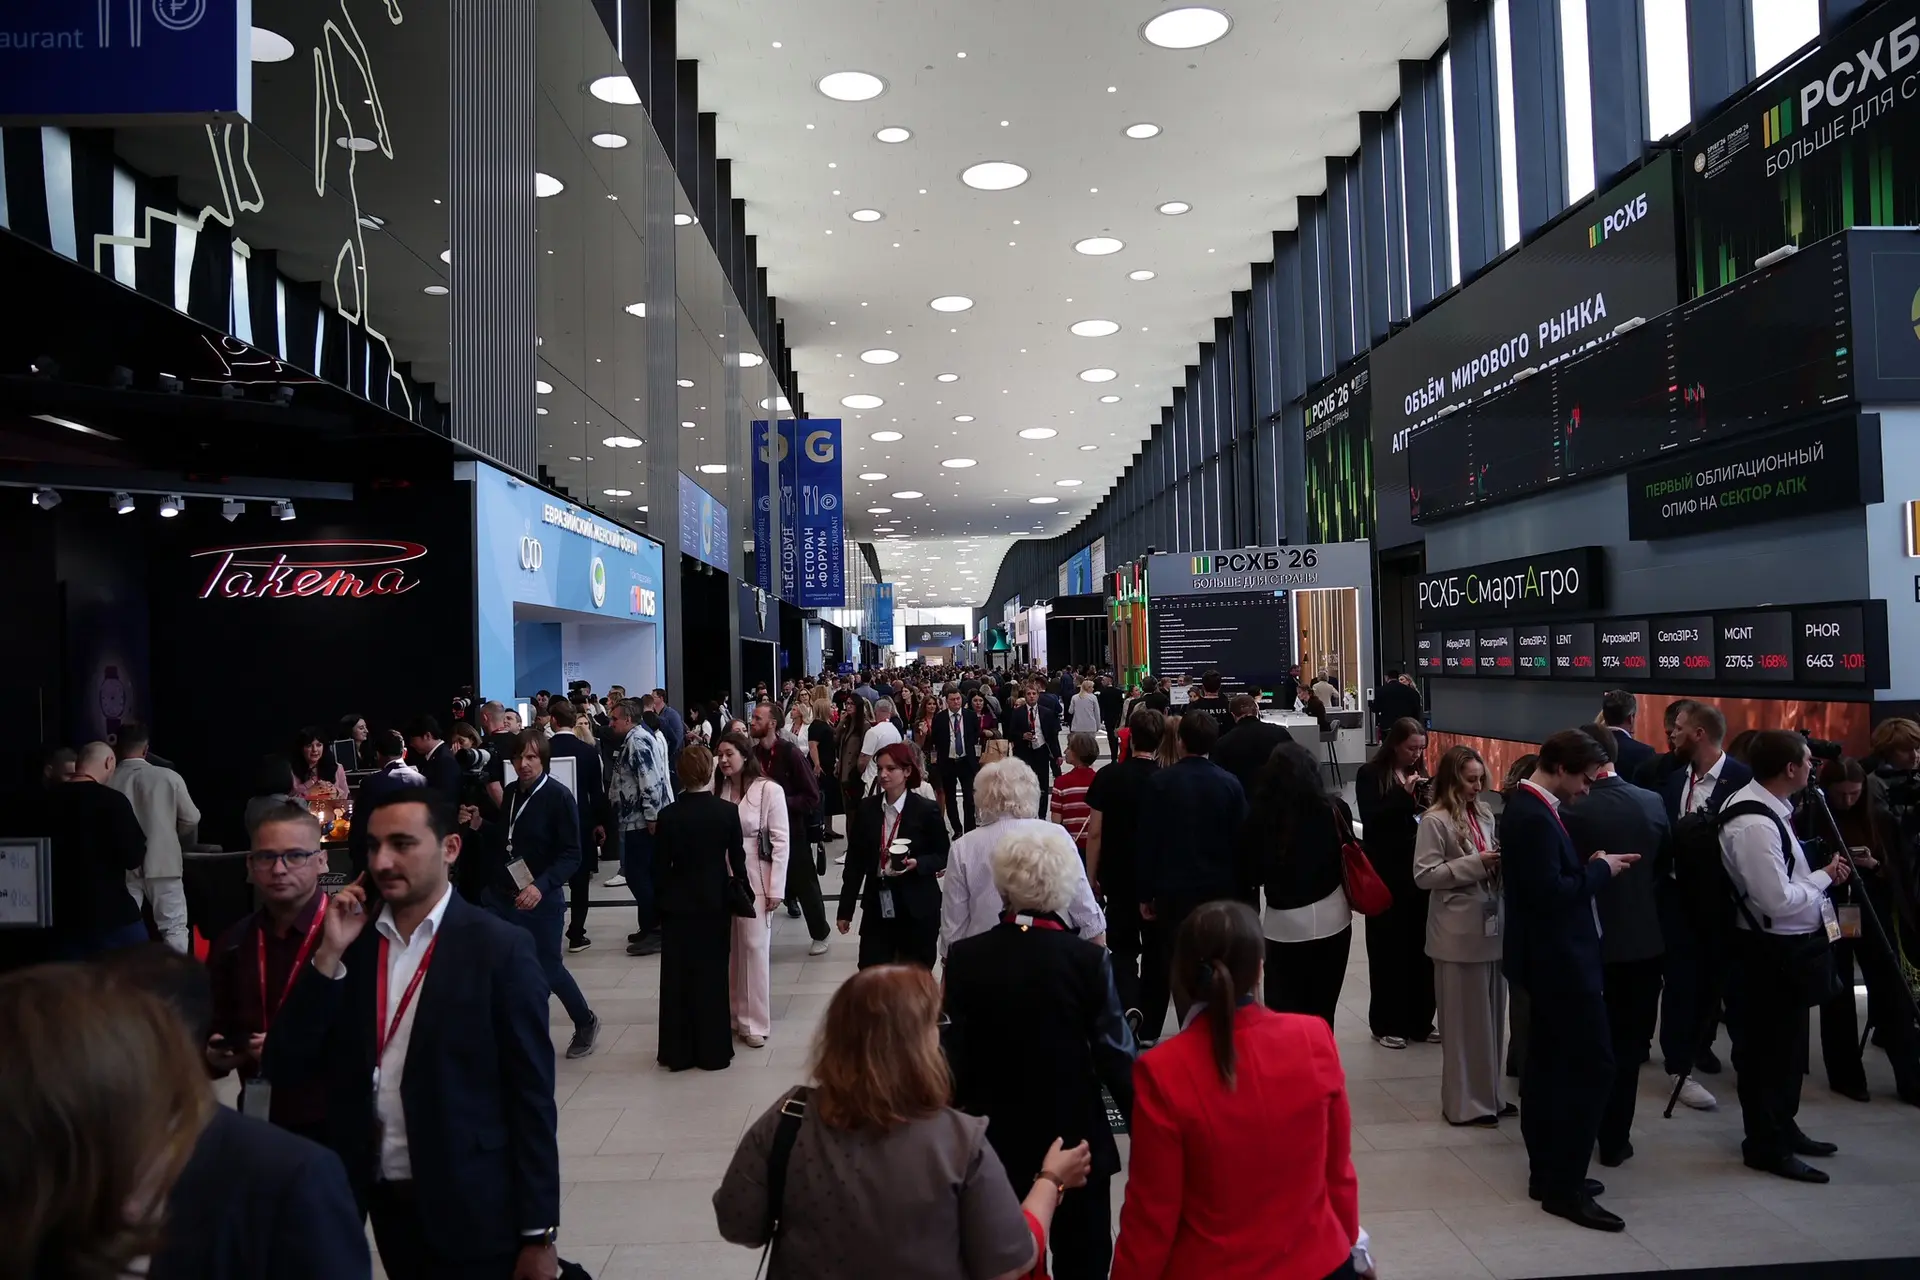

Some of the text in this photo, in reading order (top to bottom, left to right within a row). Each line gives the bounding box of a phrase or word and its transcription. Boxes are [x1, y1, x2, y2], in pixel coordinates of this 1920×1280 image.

[1800, 16, 1920, 126] РСХБ
[1766, 115, 1845, 178] БОЛЬШЕ
[1851, 87, 1894, 135] ДЛЯ
[1901, 71, 1920, 99] С
[1603, 192, 1648, 240] РСХБ
[1404, 375, 1445, 416] ОБЪЁМ
[1451, 332, 1529, 393] МИРОВОГО
[1538, 292, 1607, 350] РЫНКА
[804, 430, 834, 463] G
[1645, 440, 1824, 498] ПЕРВЫЙ ОБЛИГАЦИОННЫЙ
[1661, 476, 1808, 518] ОПИФ НА СЕКТОР АПК
[543, 503, 638, 555] ЕВРАЗИЙСКИЙ ЖЕНСКИЙ ФОРУМ
[805, 527, 815, 588] РЕСТОРАН
[817, 530, 830, 588] «ФОРУМ»
[831, 516, 840, 588] FORUM RESTAURANT
[1193, 572, 1319, 589] БОЛЬШЕ ДЛЯ СТРАНЫ
[1418, 565, 1580, 609] РСХБ-СмартАгро
[1556, 634, 1572, 645] LENT
[1724, 626, 1753, 640] MGNT
[1805, 623, 1840, 638] PHOR
[1556, 655, 1592, 667] 1682 -0,27%
[1602, 655, 1647, 668] 97,34 -0,02%
[1658, 655, 1711, 668] 99,98 -0,06%
[1725, 654, 1788, 669] 2376,5 -1,68%
[1806, 654, 1834, 668] 6463
